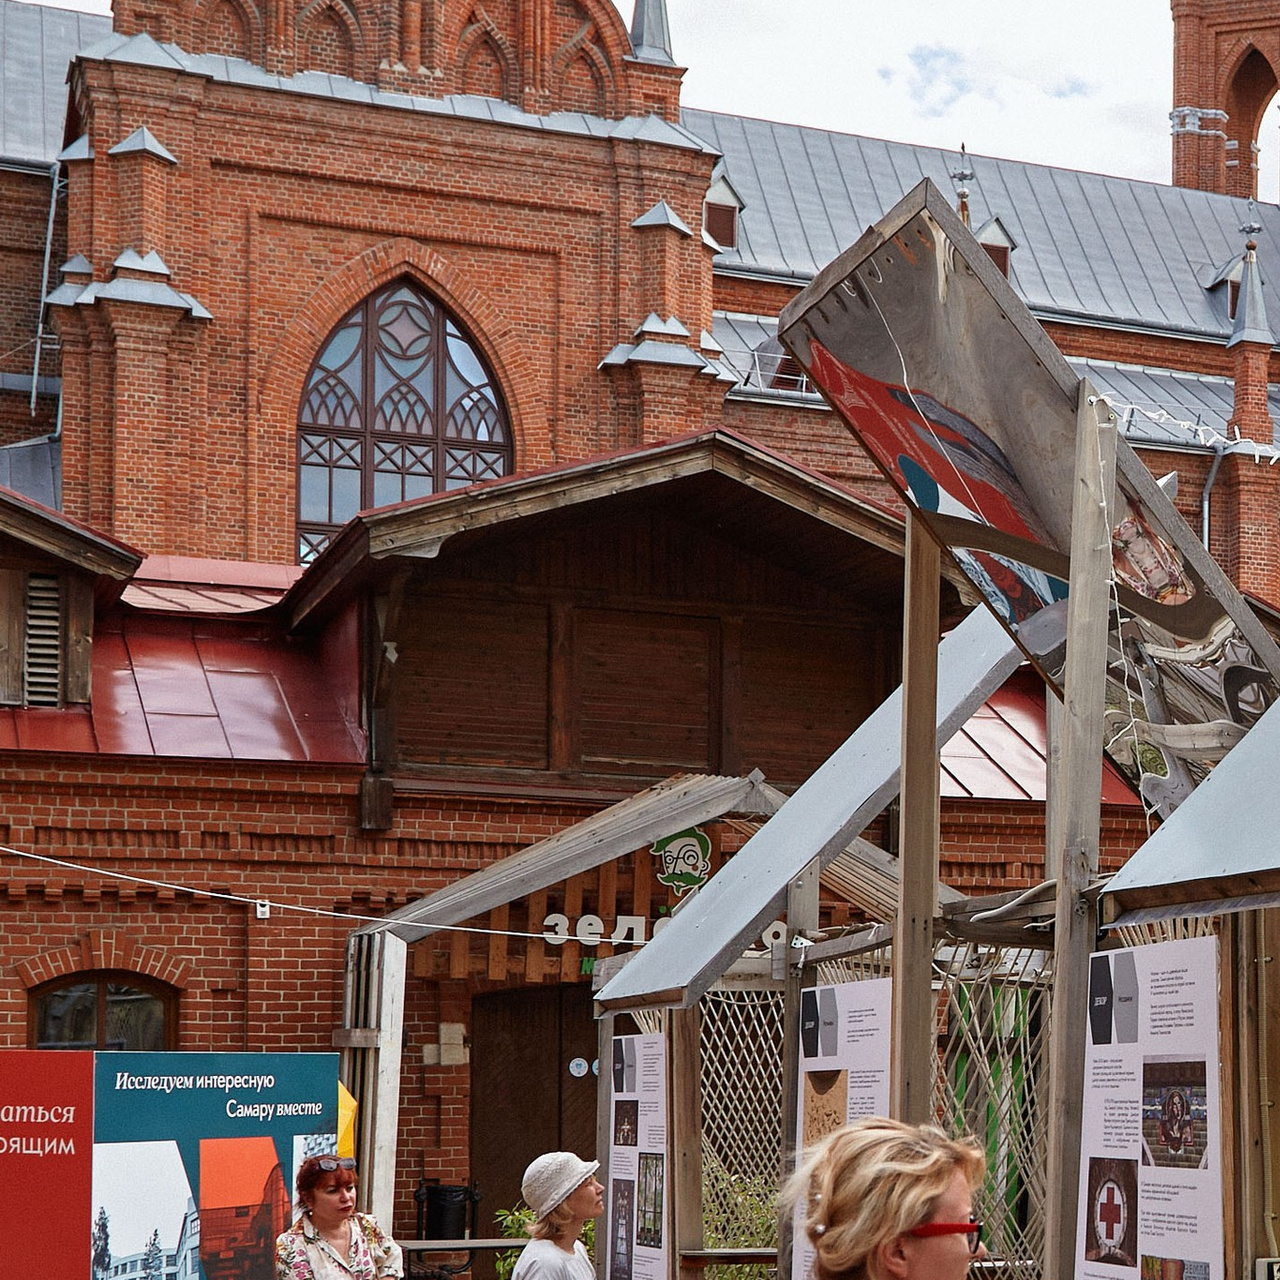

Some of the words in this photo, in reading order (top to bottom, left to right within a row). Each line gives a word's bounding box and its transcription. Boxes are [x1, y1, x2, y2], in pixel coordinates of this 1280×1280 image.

[115, 1072, 193, 1093] Исследуем
[196, 1074, 275, 1093] интересную
[226, 1099, 275, 1121] Самару
[276, 1100, 323, 1116] вместе
